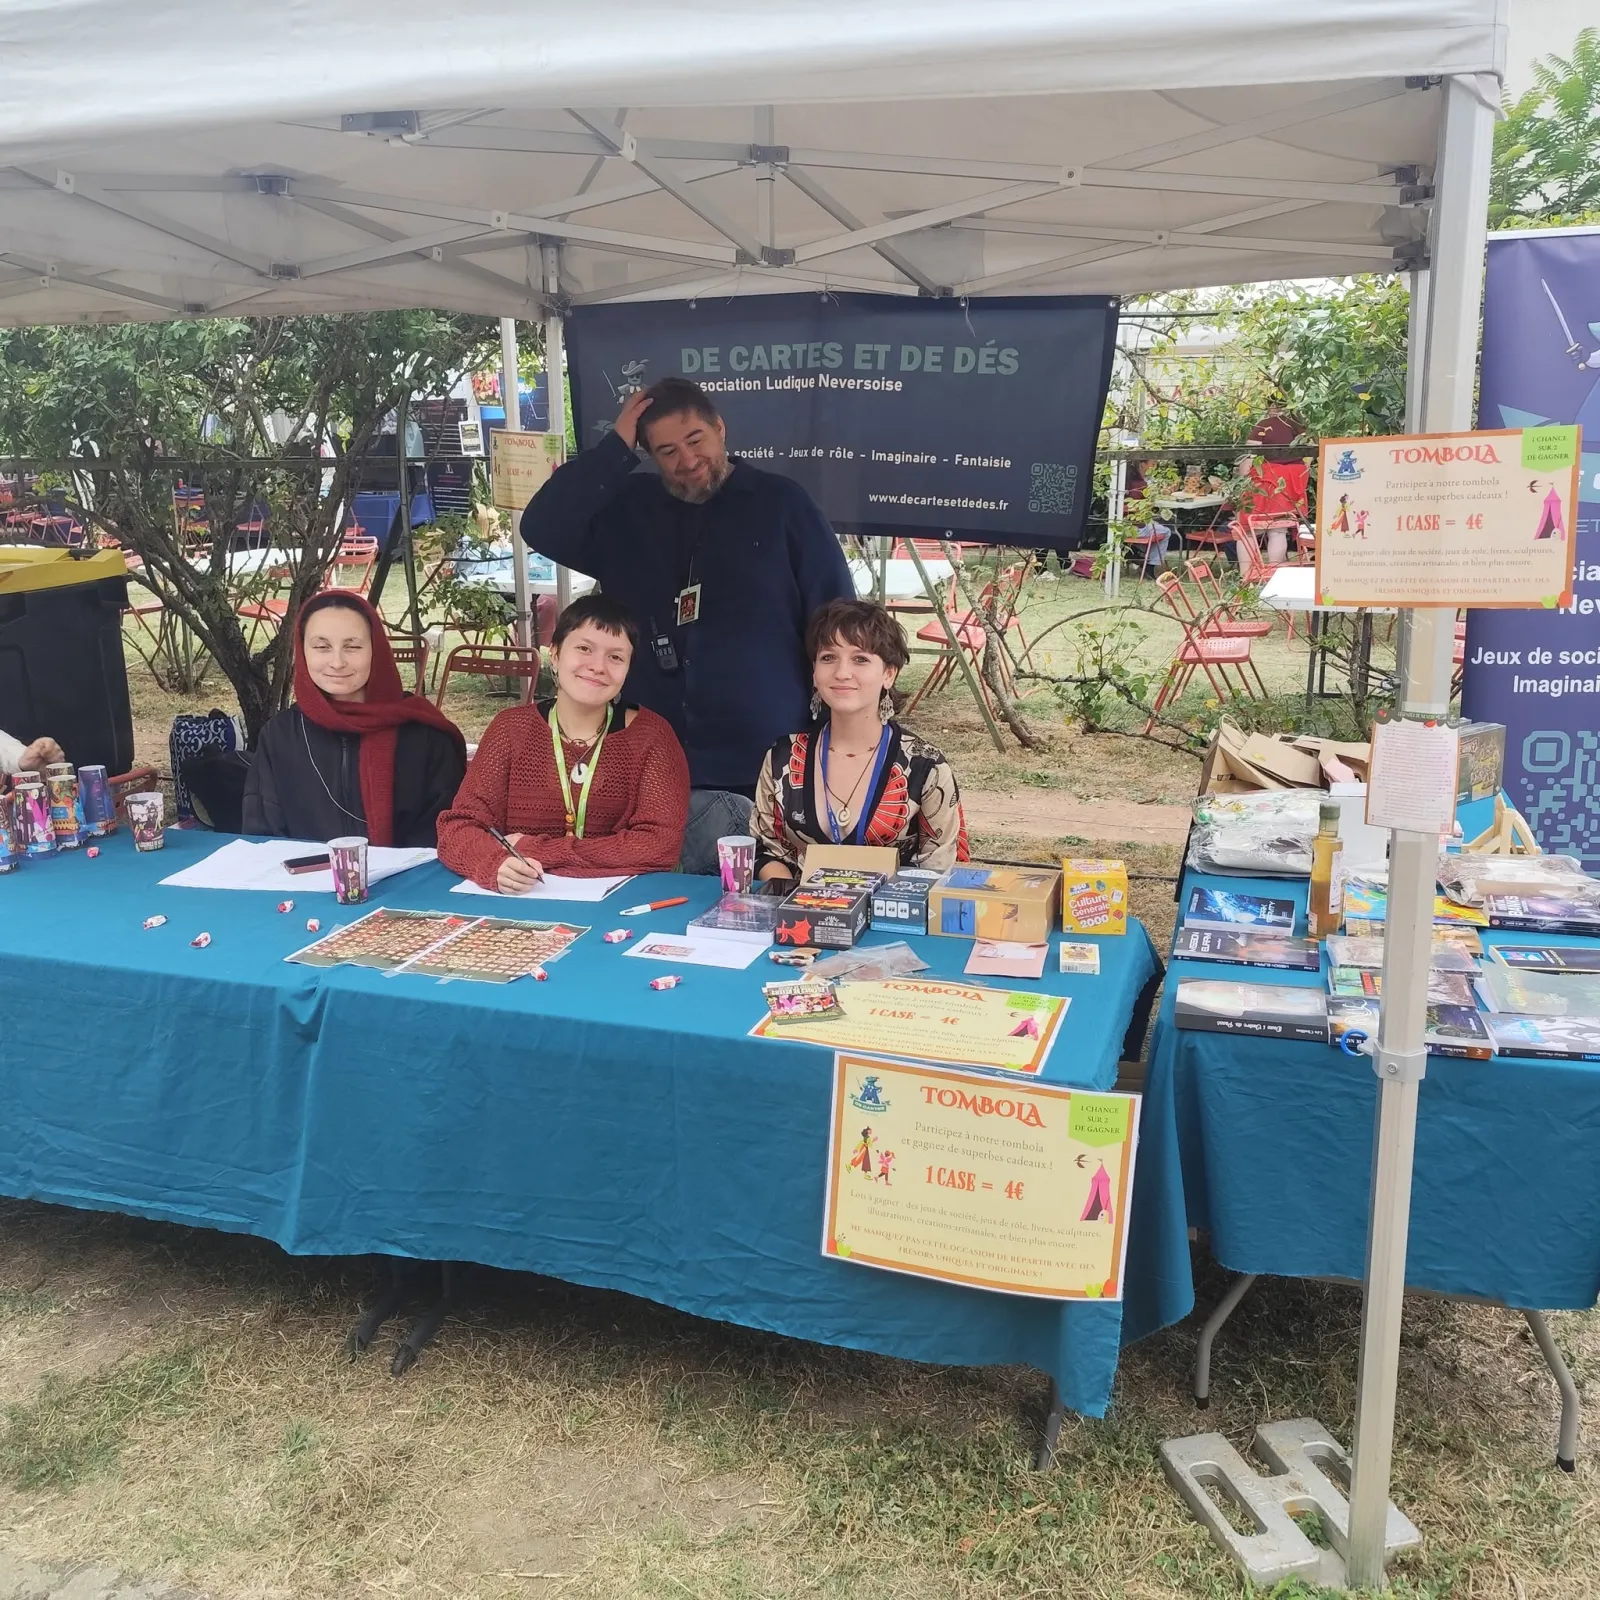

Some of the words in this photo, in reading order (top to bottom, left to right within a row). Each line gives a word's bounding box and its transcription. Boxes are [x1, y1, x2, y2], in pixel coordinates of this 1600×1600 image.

[681, 347, 720, 373] DE
[729, 342, 843, 372] CARTES
[854, 343, 891, 371] ET
[900, 345, 944, 373] DE
[953, 339, 1020, 376] DÉS
[694, 375, 761, 392] sociation
[766, 374, 815, 392] Ludique
[818, 373, 904, 392] Neversoise
[1537, 435, 1568, 443] CHANCE
[734, 446, 775, 459] société
[788, 447, 809, 459] Jeux
[811, 446, 824, 457] de
[829, 446, 854, 460] rôle
[871, 449, 937, 465] Imaginaire
[955, 453, 1012, 469] Fantaisie
[1389, 444, 1503, 466] TOMBOLA
[1538, 453, 1570, 461] GAGNER
[1385, 480, 1428, 490] Participez
[1436, 479, 1462, 488] notre
[1463, 477, 1500, 487] tombola
[869, 493, 1009, 511] www.decartesetdedes.fr
[1384, 495, 1413, 504] gagnez
[1414, 493, 1424, 502] de
[1426, 492, 1465, 503] superbes
[1467, 492, 1503, 501] cadeaux
[1406, 514, 1441, 531] CASE
[1465, 513, 1484, 531] 4€
[1471, 646, 1522, 665] Jeux
[1527, 646, 1553, 665] de
[1513, 675, 1600, 698] Imaginai
[1069, 893, 1108, 909] Culture
[1071, 903, 1111, 917] Générale
[1081, 915, 1110, 928] 2000
[881, 982, 986, 1002] TOMBOLA
[879, 1008, 916, 1020] CASE
[920, 1085, 1047, 1128] TOMBOLA
[1085, 1105, 1120, 1114] CHANCE
[915, 1121, 963, 1140] Participez
[973, 1134, 1000, 1146] notre
[1002, 1138, 1044, 1153] tombola
[1074, 1124, 1085, 1132] DE
[1086, 1126, 1120, 1134] GAGNER
[901, 1137, 910, 1146] et
[912, 1140, 945, 1151] gagnez
[947, 1143, 959, 1153] de
[961, 1147, 1004, 1162] superbes
[1006, 1155, 1047, 1170] cadeaux
[926, 1165, 933, 1184] 1
[937, 1167, 977, 1192] CASE
[1004, 1180, 1025, 1200] 4€
[850, 1189, 867, 1200] Lots
[873, 1196, 900, 1208] gagner
[905, 1201, 919, 1210] des
[920, 1204, 936, 1214] jeux
[938, 1206, 948, 1216] de
[949, 1210, 979, 1223] société,
[980, 1215, 997, 1225] jeux
[999, 1218, 1009, 1228] de
[1011, 1220, 1029, 1231] rôle,
[1031, 1223, 1055, 1234] livres,
[1056, 1227, 1102, 1239] sculptures,
[867, 1206, 915, 1223] illustrations,
[917, 1218, 952, 1231] créations
[954, 1225, 997, 1240] artisanales,
[999, 1232, 1007, 1240] et
[1009, 1232, 1027, 1243] bien
[1029, 1237, 1046, 1247] plus
[1048, 1241, 1078, 1250] encore.
[864, 1228, 904, 1241] MANQUEZ
[906, 1235, 921, 1245] PAS
[922, 1239, 948, 1250] CETTE
[949, 1244, 995, 1259] OCCASION
[997, 1252, 1009, 1262] DE
[1010, 1255, 1052, 1268] REPARTIR
[1055, 1261, 1077, 1270] AVEC
[1079, 1263, 1096, 1271] DES
[937, 1255, 974, 1268] UNIQUES
[976, 1261, 985, 1270] ET
[987, 1263, 1038, 1278] ORIGINAUX
